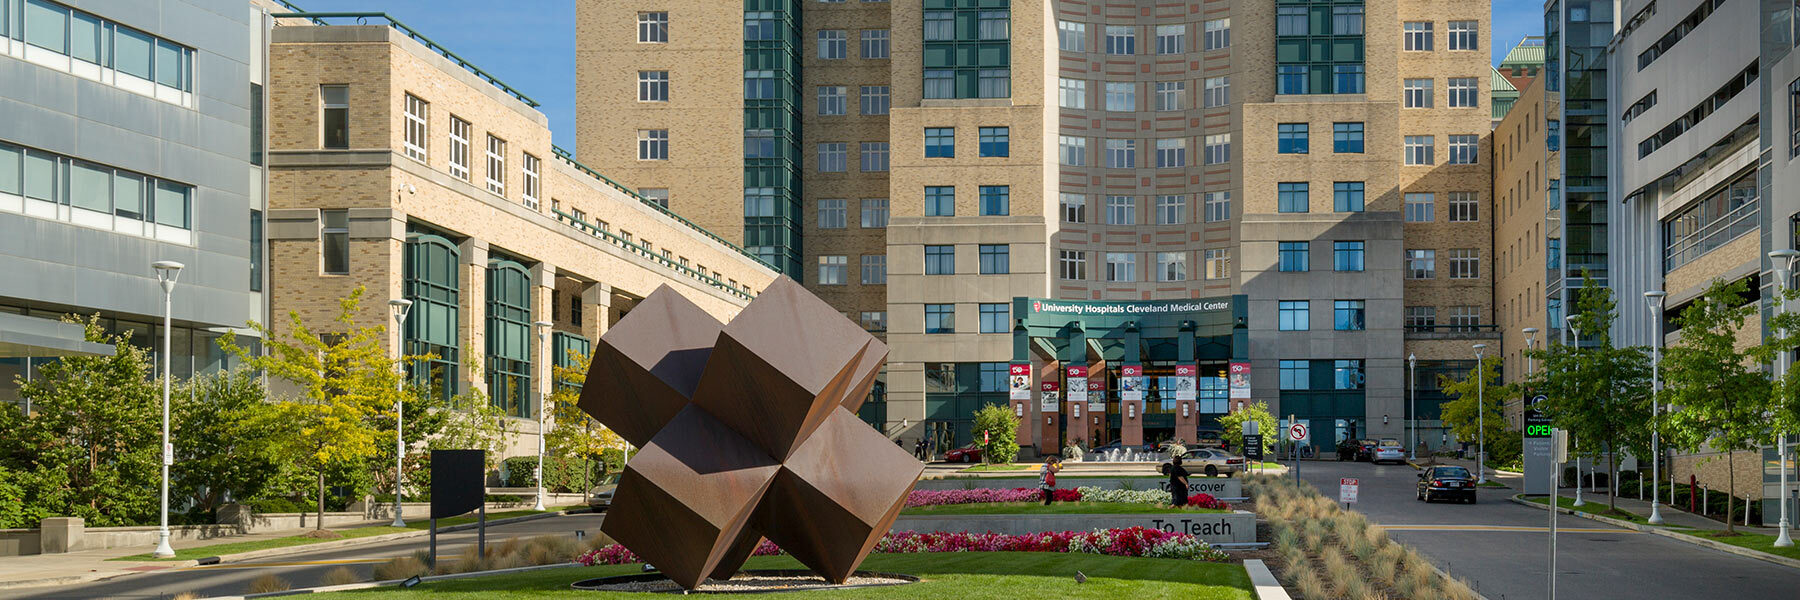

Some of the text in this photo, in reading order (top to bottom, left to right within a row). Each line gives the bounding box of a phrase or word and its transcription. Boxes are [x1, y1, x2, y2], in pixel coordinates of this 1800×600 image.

[1042, 302, 1229, 314] University Hospitals Cleveland Medical Center
[1152, 519, 1231, 535] To Teach
